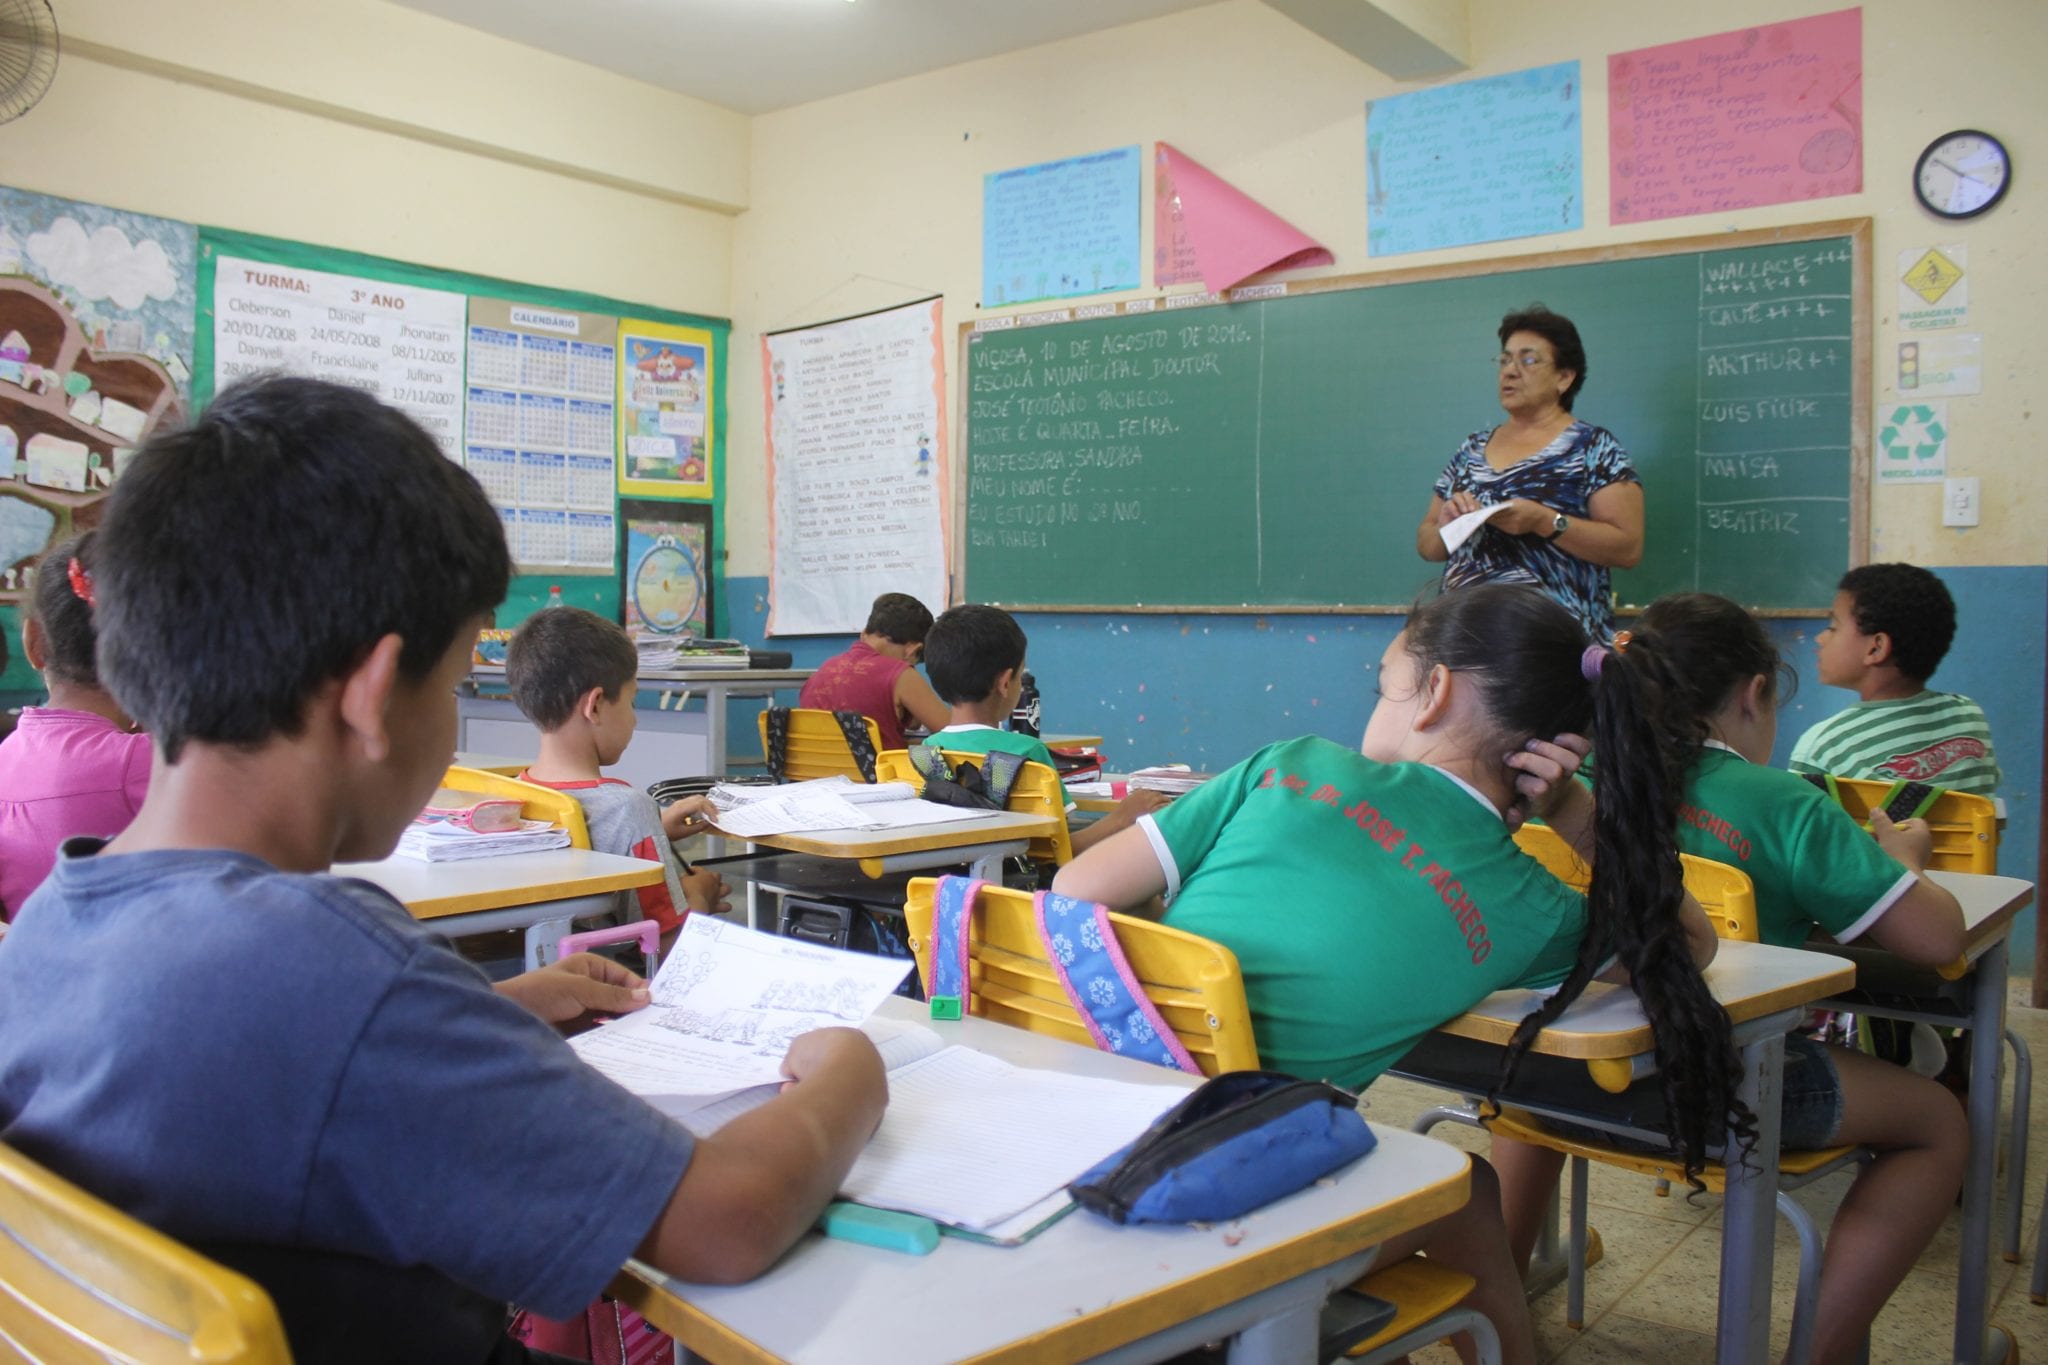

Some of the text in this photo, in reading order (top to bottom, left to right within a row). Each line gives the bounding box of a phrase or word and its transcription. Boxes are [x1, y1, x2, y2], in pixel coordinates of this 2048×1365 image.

[1707, 255, 1811, 282] WALLACE
[244, 271, 311, 294] TURMA:
[229, 298, 291, 320] Cleberson
[371, 296, 405, 311] ANO
[977, 317, 1011, 331] ESCOLA
[1232, 286, 1282, 300] PACHECO
[328, 308, 365, 326] Daniel
[513, 311, 577, 329] CALENDÁRIO
[223, 320, 297, 343] 20/01/2008
[310, 327, 381, 349] 24/05/2008
[1070, 340, 1091, 359] DE
[1102, 329, 1168, 355] AGOSTO
[1178, 325, 1203, 349] DE
[974, 368, 1034, 392] ESCOLA
[1148, 351, 1222, 381] DOUTOR
[1707, 347, 1804, 377] ARTHUR
[406, 368, 443, 384] Juliana
[970, 475, 1006, 498] MEU
[1011, 475, 1057, 498] NOME
[1706, 508, 1800, 535] BEATRIZ
[1677, 802, 1752, 862] PACHECO
[1401, 843, 1424, 870] T.
[1419, 861, 1492, 966] PACHECO
